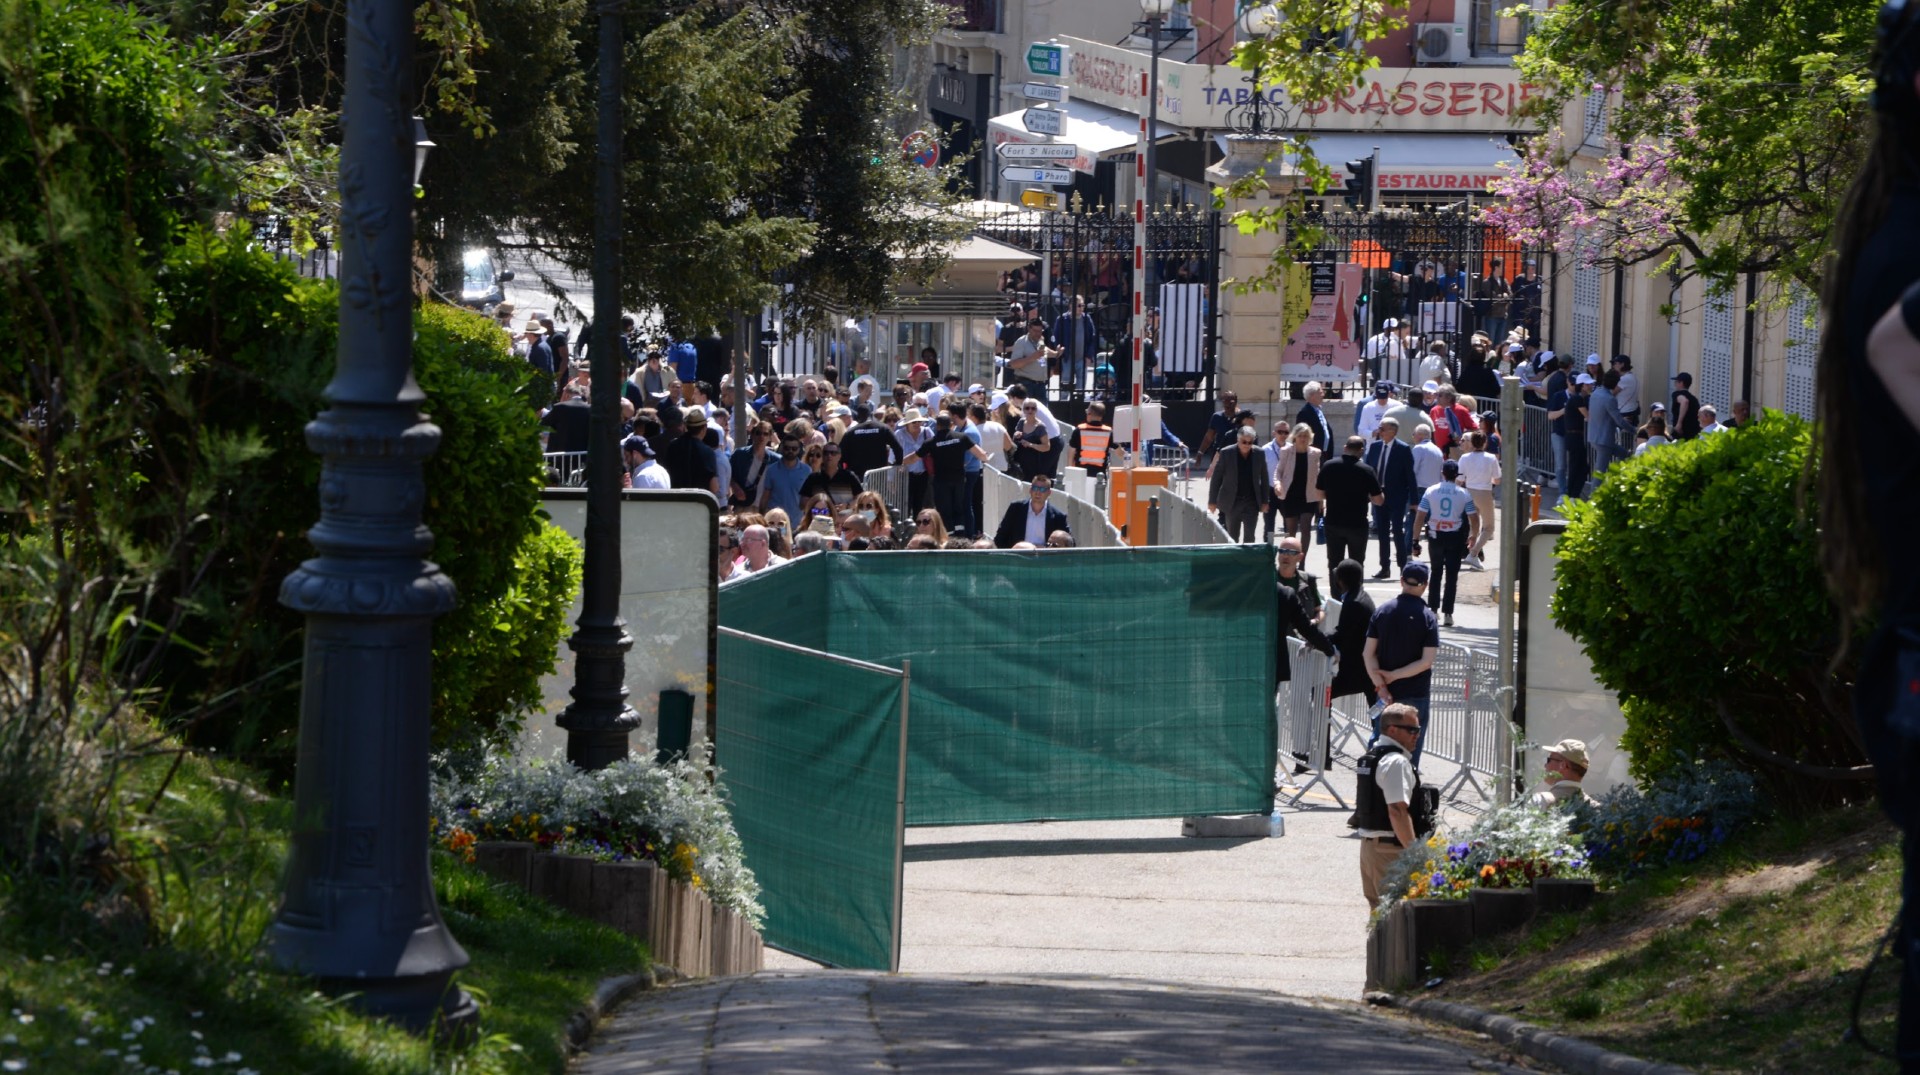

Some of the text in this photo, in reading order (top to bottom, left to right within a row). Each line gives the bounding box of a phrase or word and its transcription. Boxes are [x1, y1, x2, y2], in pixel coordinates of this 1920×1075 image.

[1038, 87, 1060, 98] LAMBERT
[1007, 147, 1025, 155] Fort
[1041, 147, 1074, 156] Nicolas
[1045, 172, 1068, 182] Pharo
[1378, 174, 1503, 189] ESTAURANT
[1440, 497, 1452, 518] 9
